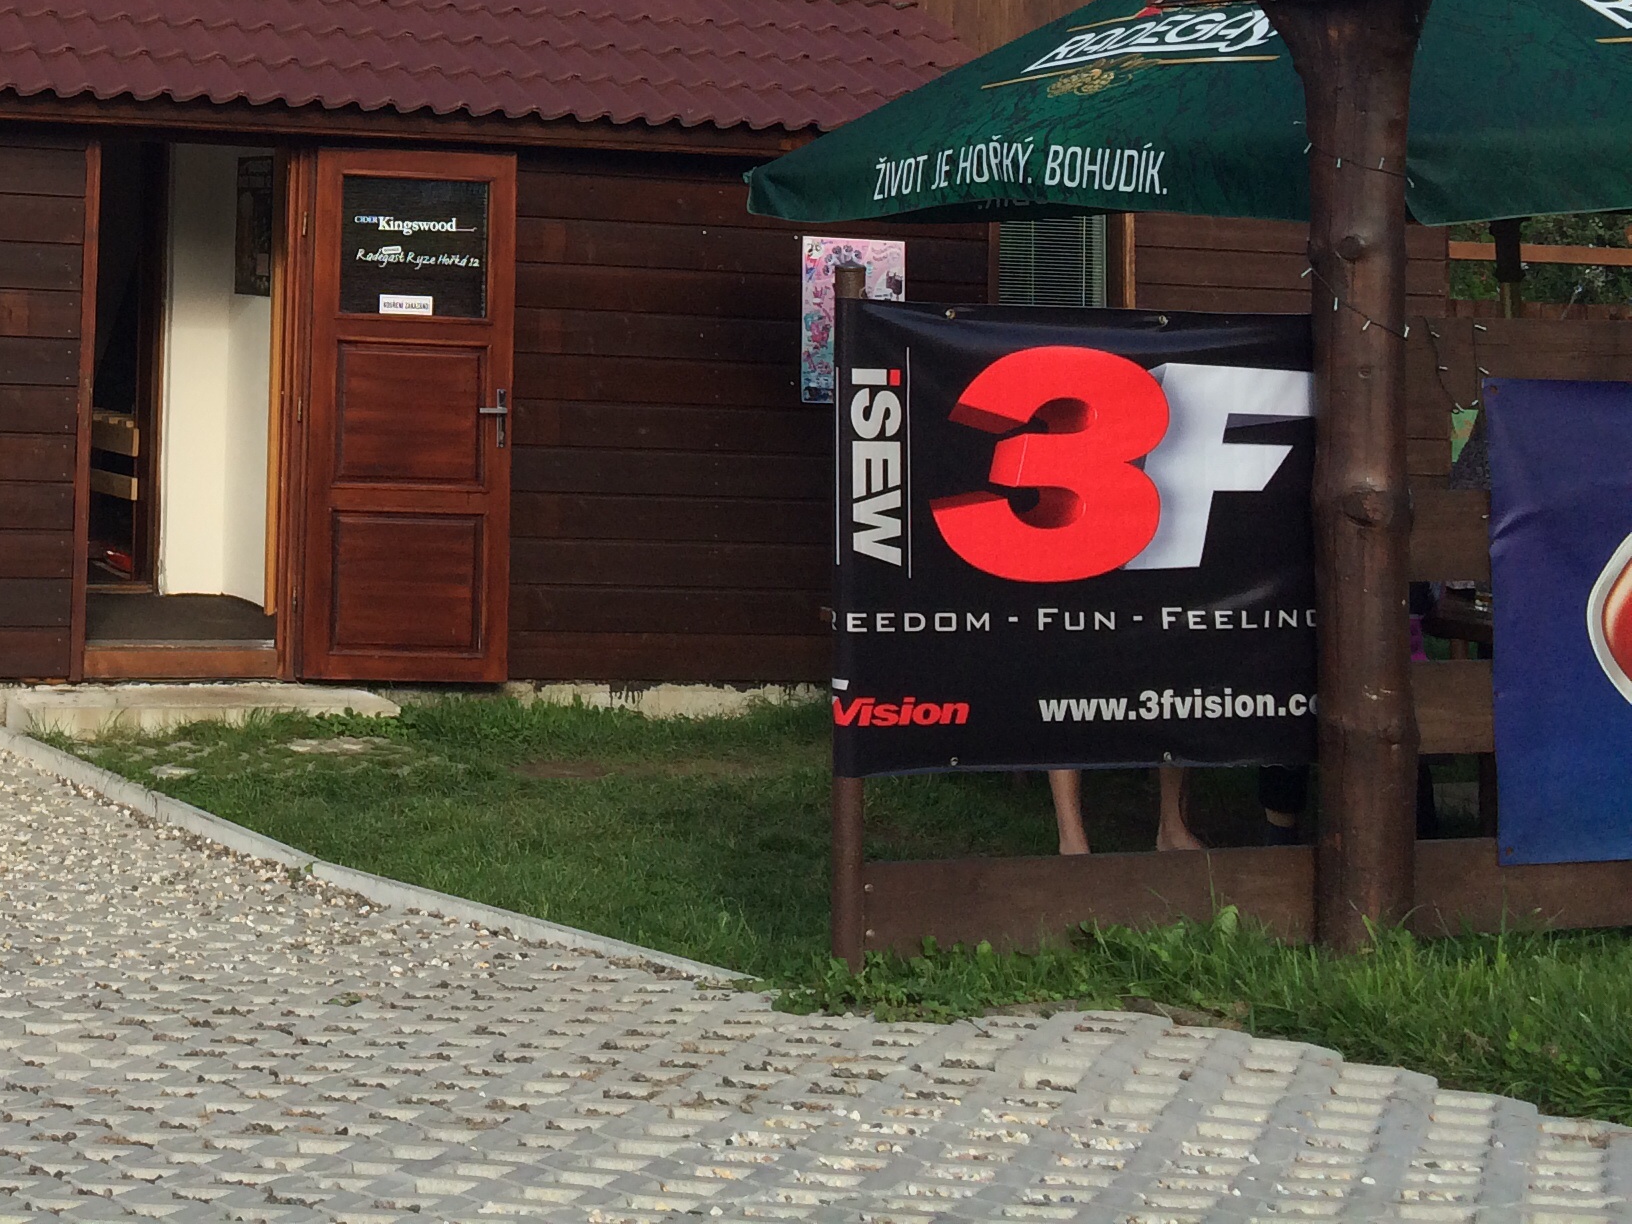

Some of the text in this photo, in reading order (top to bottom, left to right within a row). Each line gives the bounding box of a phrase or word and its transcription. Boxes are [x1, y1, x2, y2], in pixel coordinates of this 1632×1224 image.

[1020, 9, 1278, 74] RADEGAS
[873, 134, 1168, 201] ŽIVOT JE HOŘKÝ. BOHUDÍK.
[378, 216, 457, 236] Kingswood
[355, 248, 405, 267] Radegast
[468, 256, 481, 267] 12
[929, 345, 1316, 582] 3F
[831, 610, 990, 633] EEDOM
[832, 696, 971, 727] Vision
